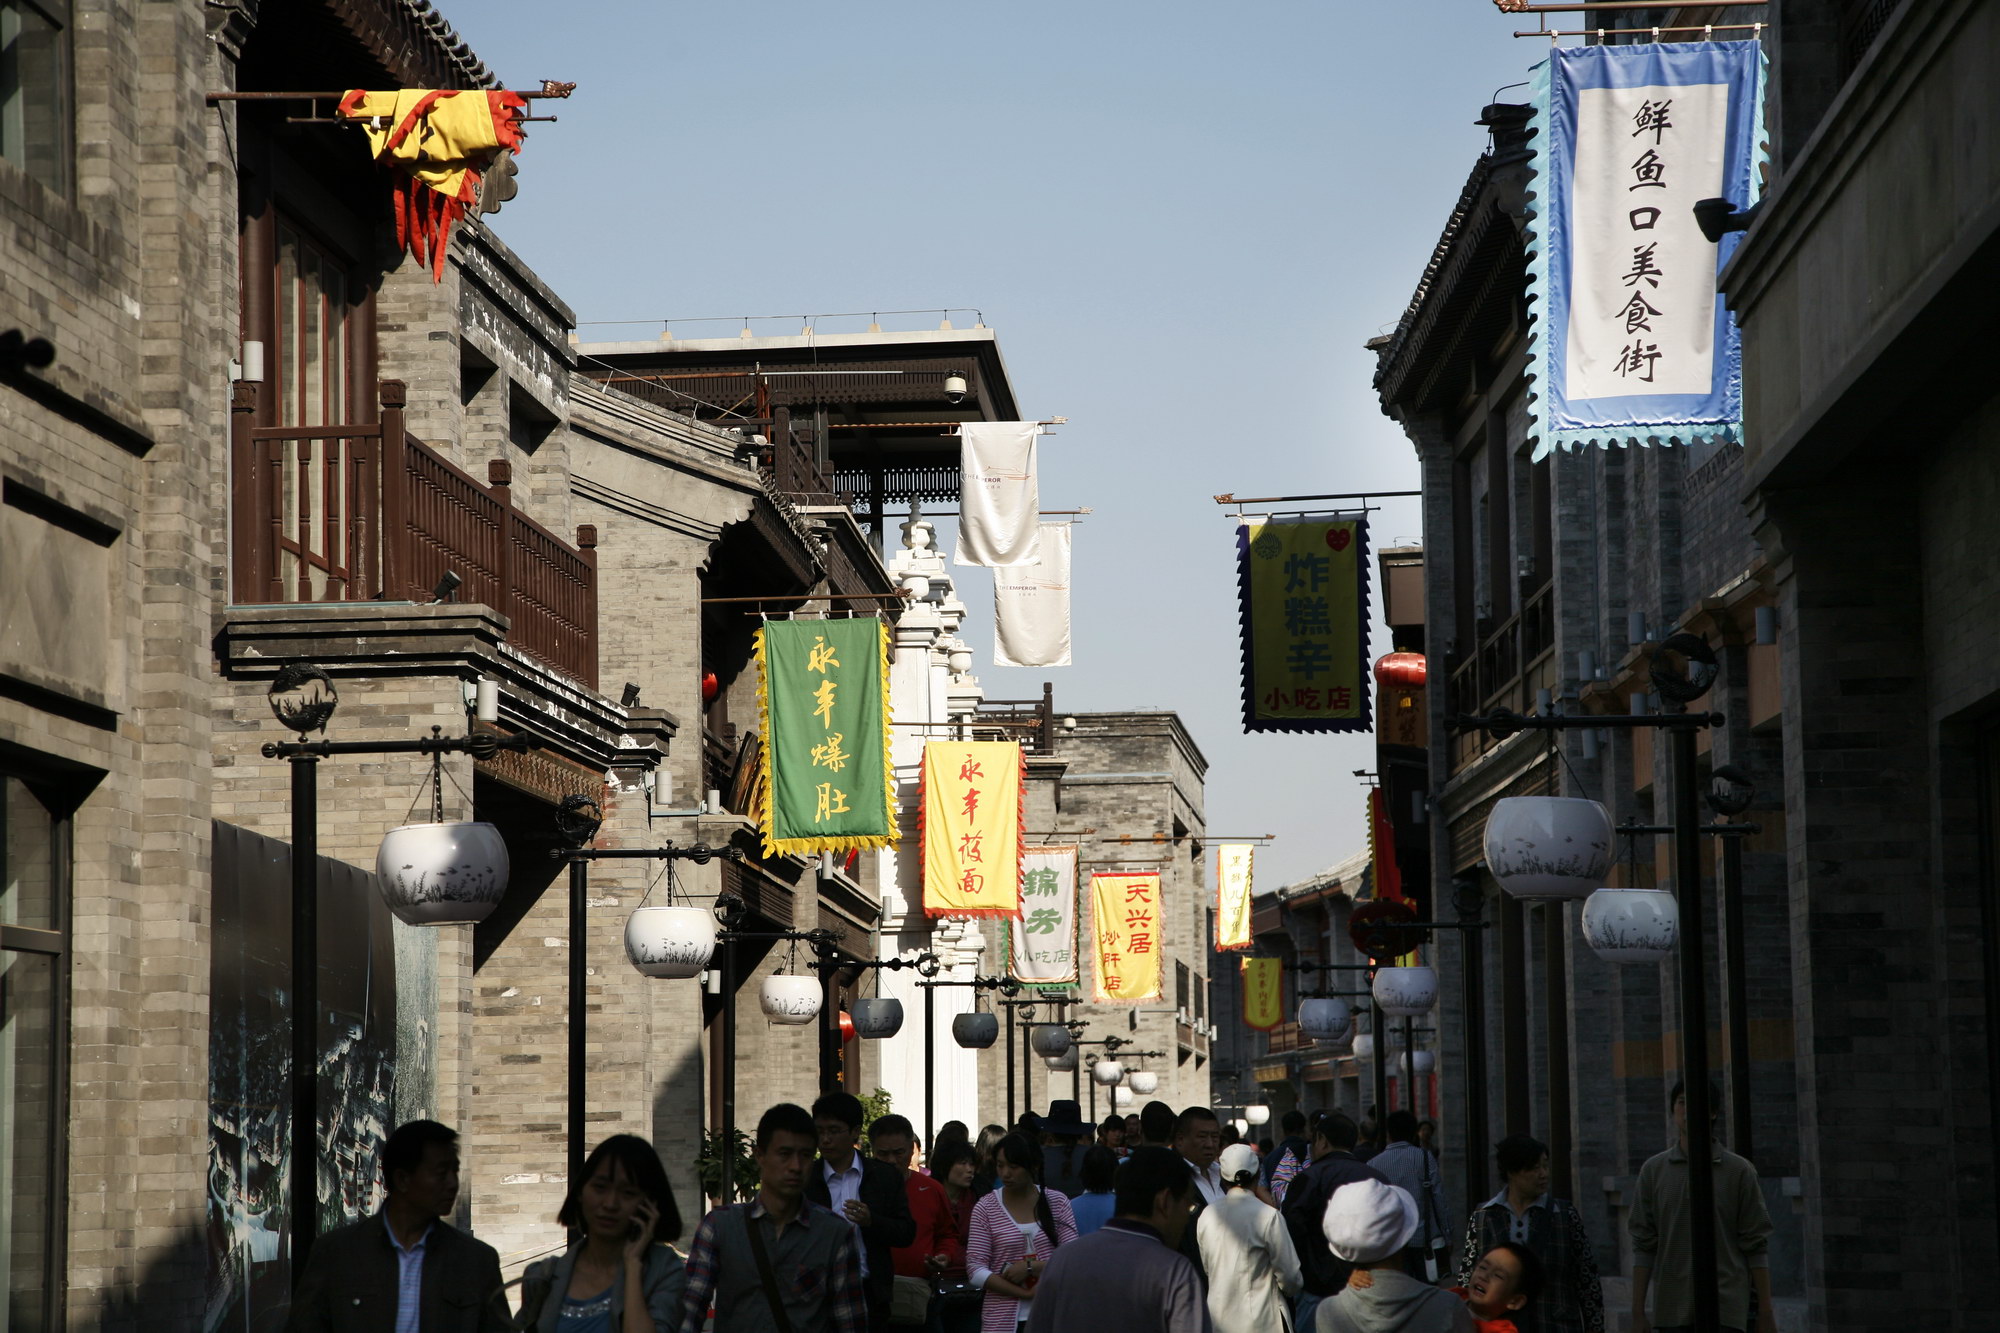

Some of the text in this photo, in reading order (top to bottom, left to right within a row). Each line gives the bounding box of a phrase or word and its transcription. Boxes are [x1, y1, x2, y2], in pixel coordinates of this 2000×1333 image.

[1613, 99, 1673, 383] 鲜鱼口美食街
[1284, 552, 1332, 680] 炸糕辛
[1264, 687, 1351, 712] 小吃店
[1125, 884, 1153, 954] 天兴居
[1017, 949, 1070, 964] 小吃店
[1102, 931, 1122, 991] 炒肝店
